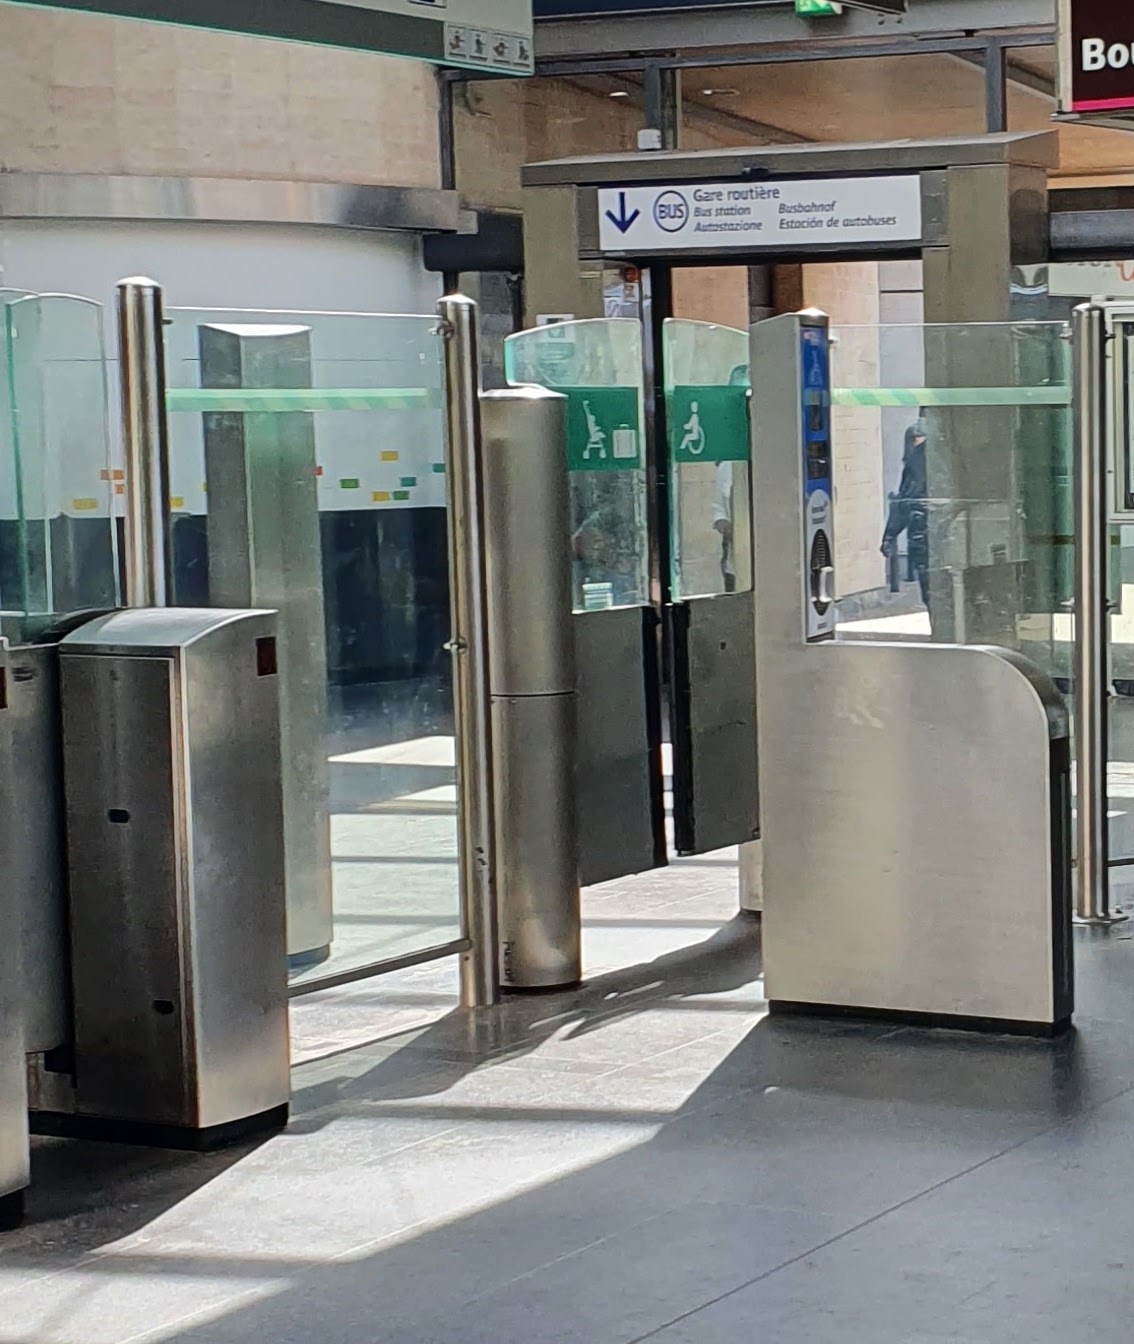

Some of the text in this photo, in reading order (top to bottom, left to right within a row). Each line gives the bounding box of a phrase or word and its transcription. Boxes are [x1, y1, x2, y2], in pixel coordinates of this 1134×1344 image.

[693, 186, 780, 202] Gare routière
[658, 203, 685, 220] BUS
[693, 205, 752, 217] Bus station
[693, 220, 763, 233] Autostazione
[778, 215, 897, 230] Estación de autobuses
